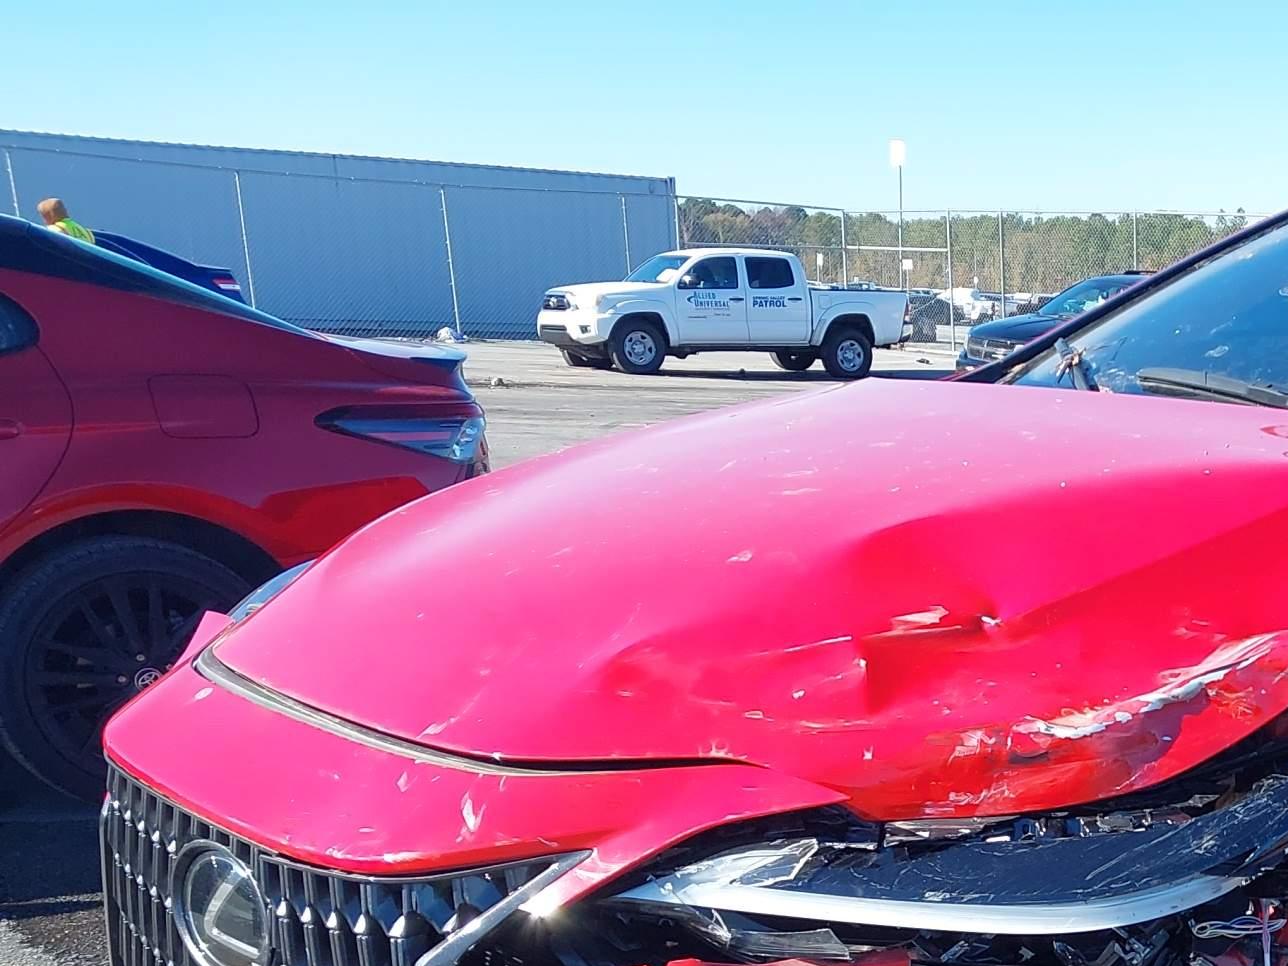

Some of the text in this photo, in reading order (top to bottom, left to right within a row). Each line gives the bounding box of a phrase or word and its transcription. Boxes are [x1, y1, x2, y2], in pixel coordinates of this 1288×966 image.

[693, 291, 716, 299] ALLIED
[694, 299, 730, 307] UNIVERSAL
[752, 300, 788, 308] PATROL
